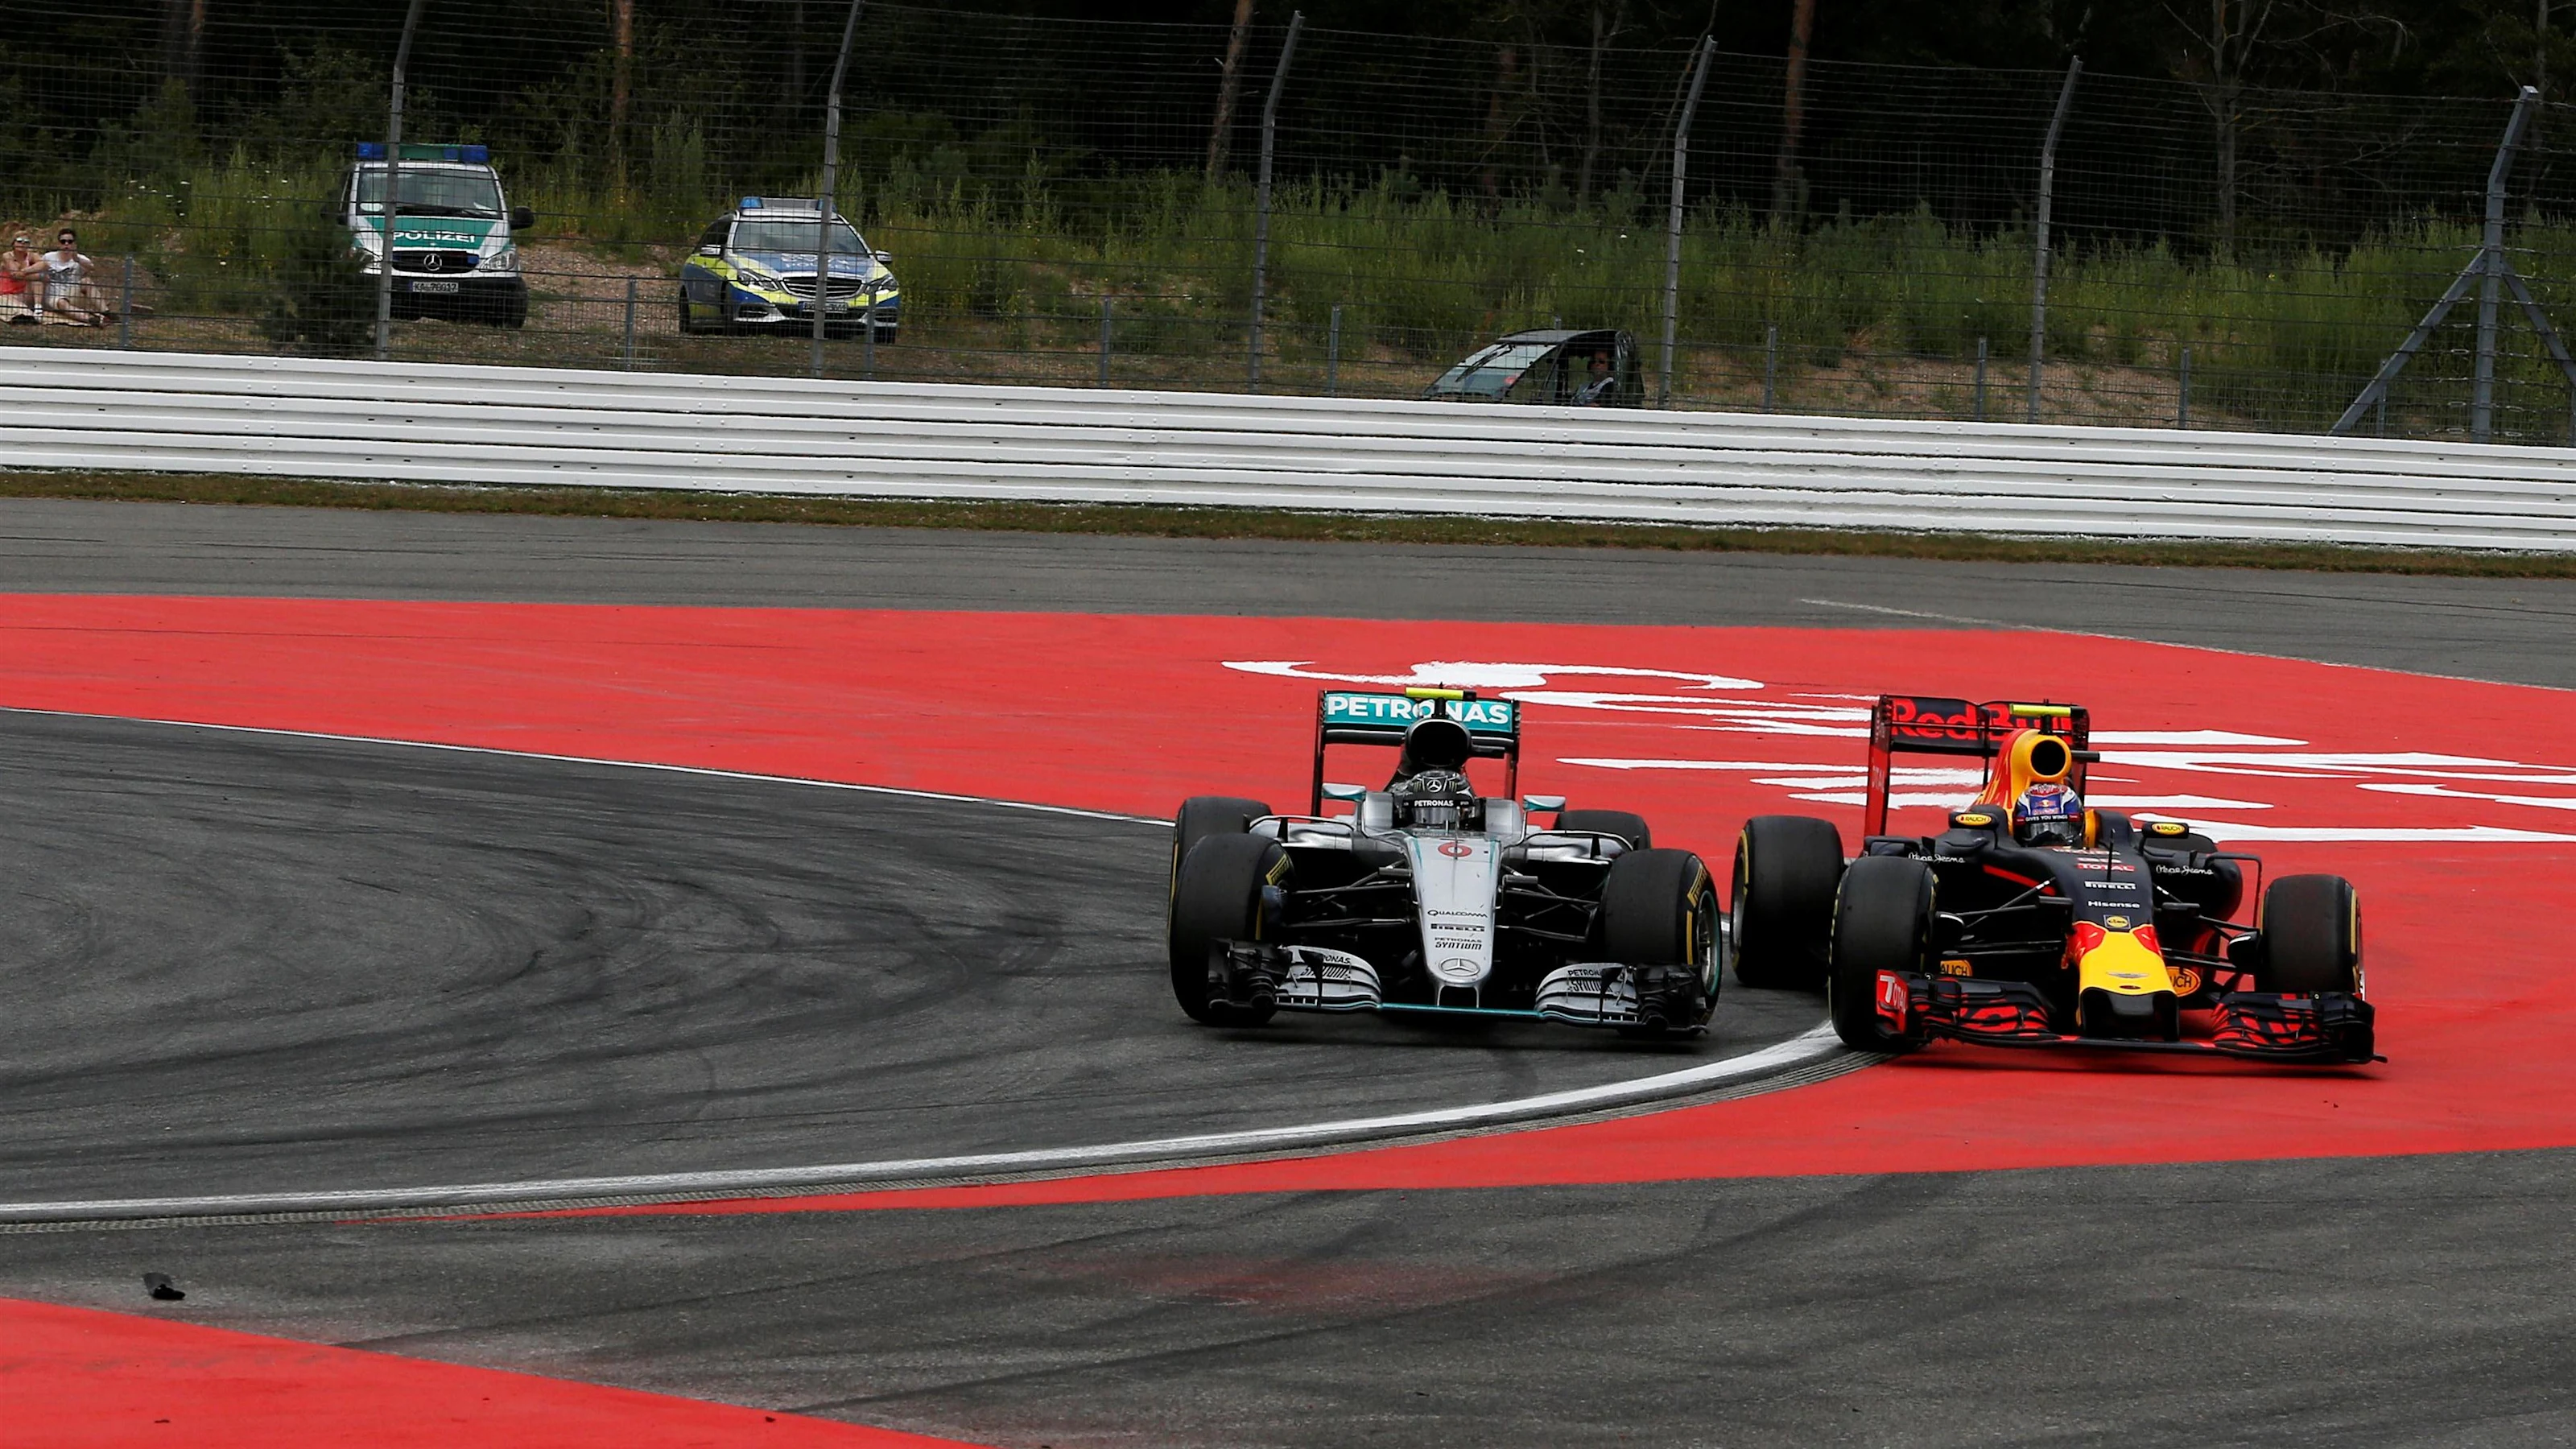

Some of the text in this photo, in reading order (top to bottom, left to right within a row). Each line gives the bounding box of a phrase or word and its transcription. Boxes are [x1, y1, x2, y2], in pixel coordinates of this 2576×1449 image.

[393, 230, 475, 243] POLIZEI
[1327, 696, 1509, 724] PETRONAS
[1892, 699, 1979, 741] Red
[1414, 799, 1454, 807] PETRONAS
[2077, 863, 2135, 872] TOTAL
[2084, 881, 2136, 890] PIRELLI
[1427, 910, 1488, 919] QUALCOMM
